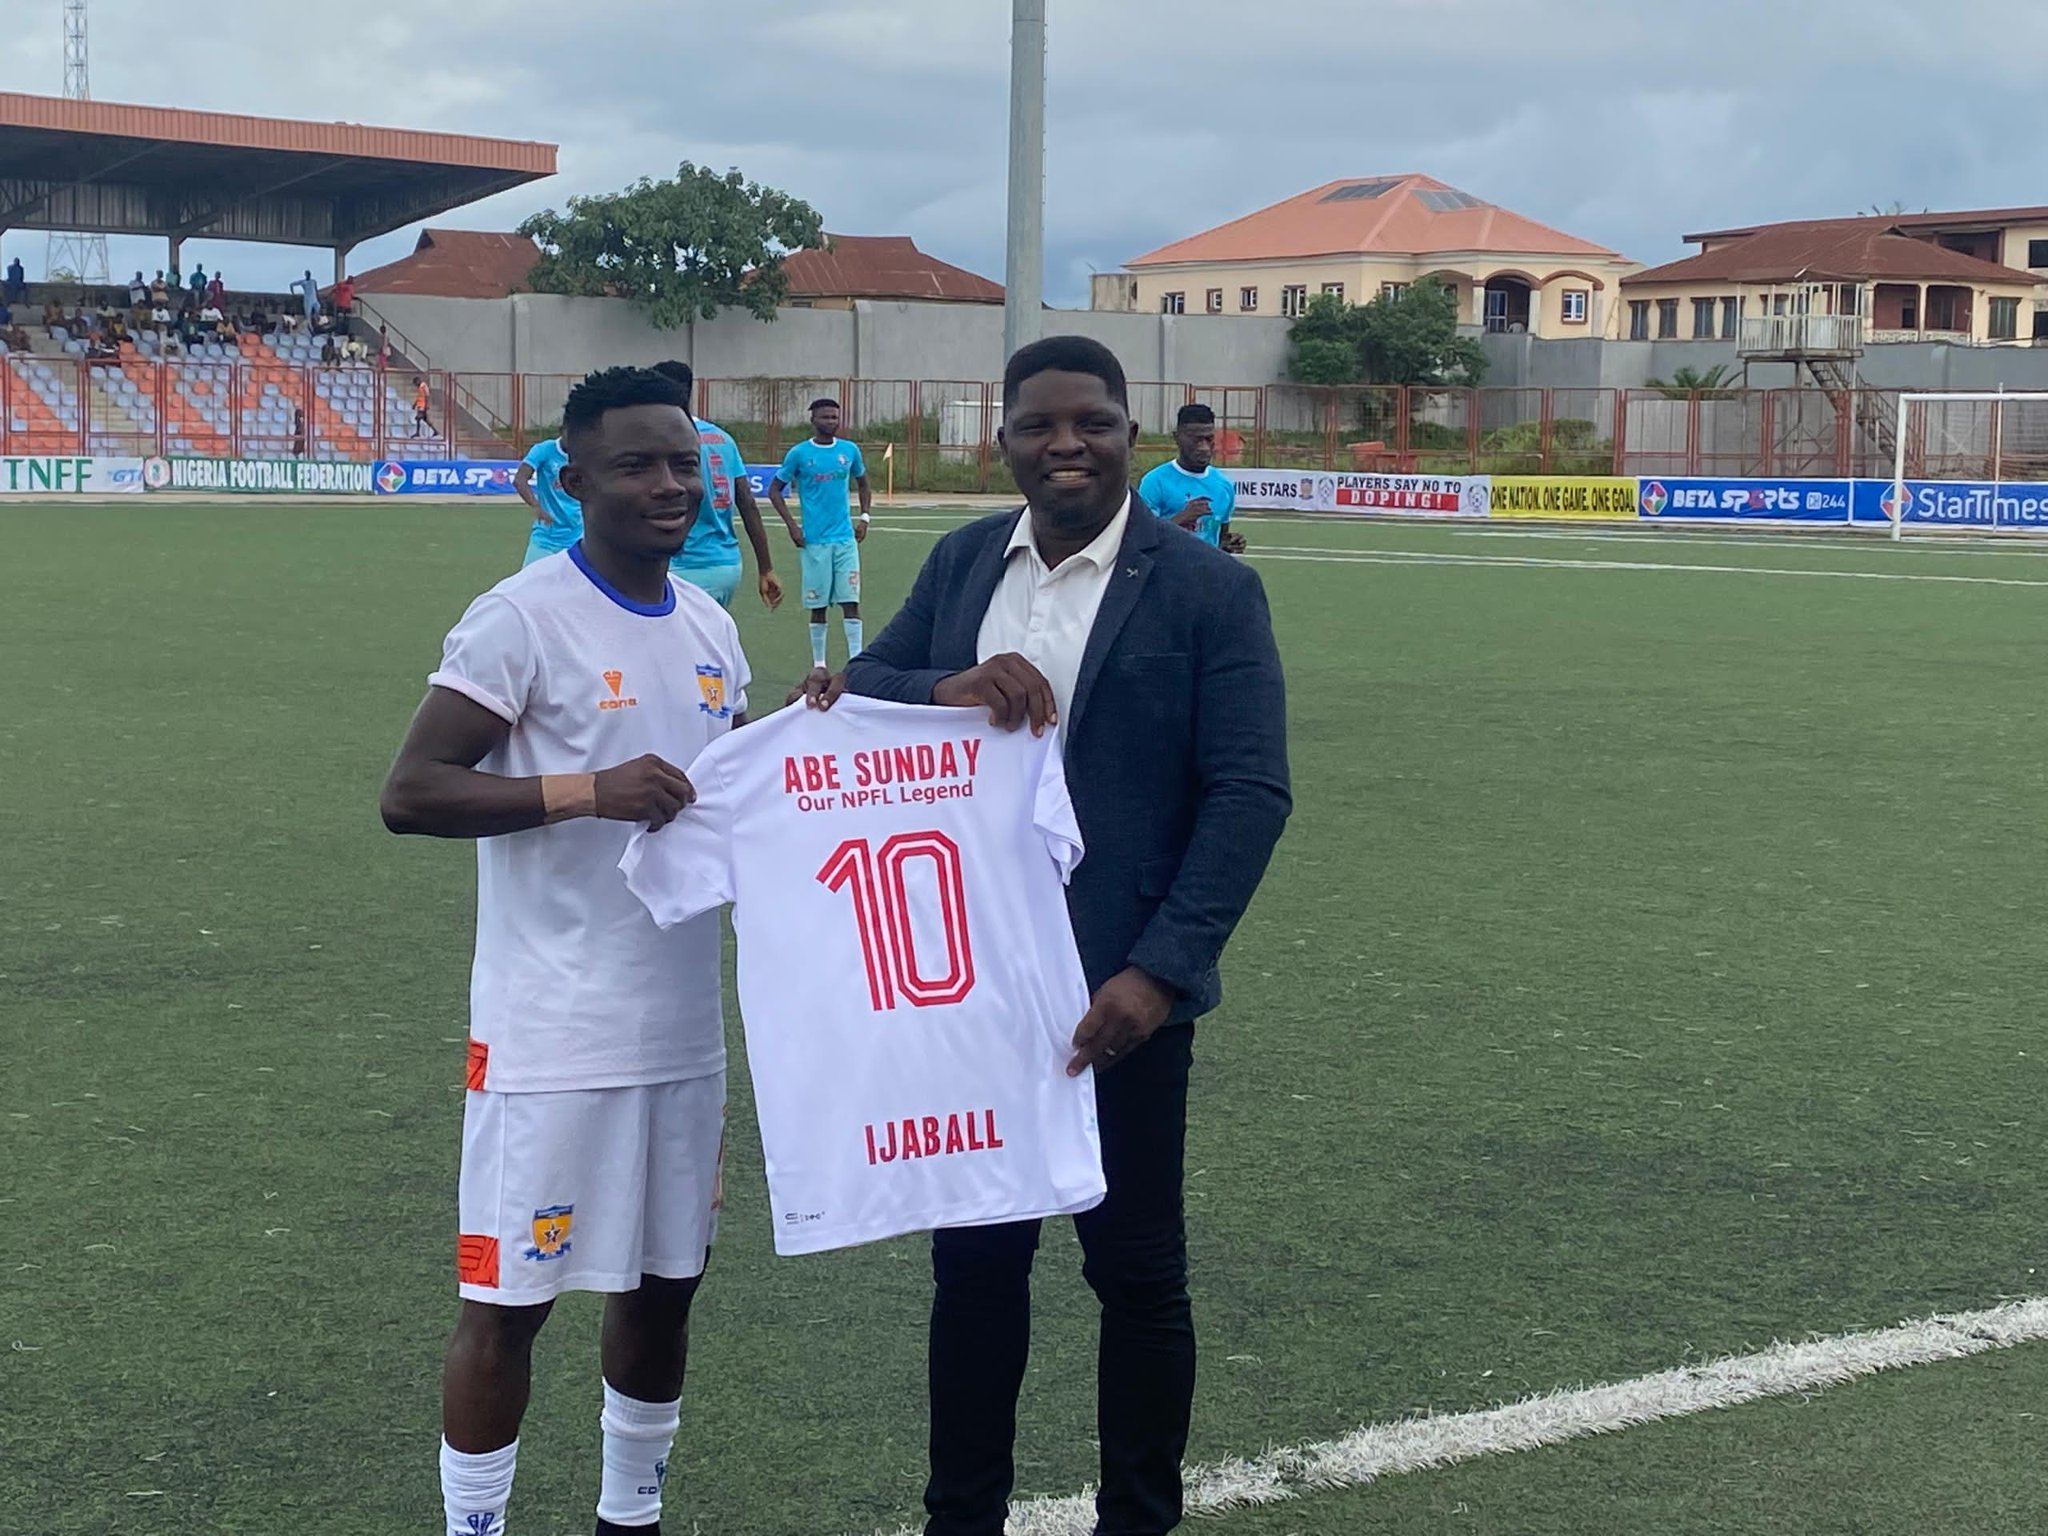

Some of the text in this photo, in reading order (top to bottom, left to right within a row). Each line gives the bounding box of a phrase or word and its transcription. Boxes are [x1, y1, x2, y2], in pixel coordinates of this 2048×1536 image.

[2, 459, 93, 492] TNFF
[172, 459, 373, 491] NIGERIA FOOTBALL FEDERATION
[412, 468, 460, 485] BETA
[1260, 482, 1297, 498] STARS
[1337, 476, 1462, 494] PLAYERS SAY NO TO
[1350, 490, 1442, 509] DOPING!
[1491, 486, 1507, 509] ONE
[1543, 487, 1560, 511] ONE
[1592, 488, 1610, 512] ONE
[1612, 488, 1635, 512] GOAL
[1673, 489, 1716, 508] BETA
[1823, 494, 1846, 508] 244
[1918, 488, 2048, 520] StarTimes
[785, 739, 981, 793] ABE SUNDAY
[798, 780, 973, 812] Our NPFL Legend
[816, 830, 976, 1011] 10
[865, 1109, 1003, 1165] IJABALL
